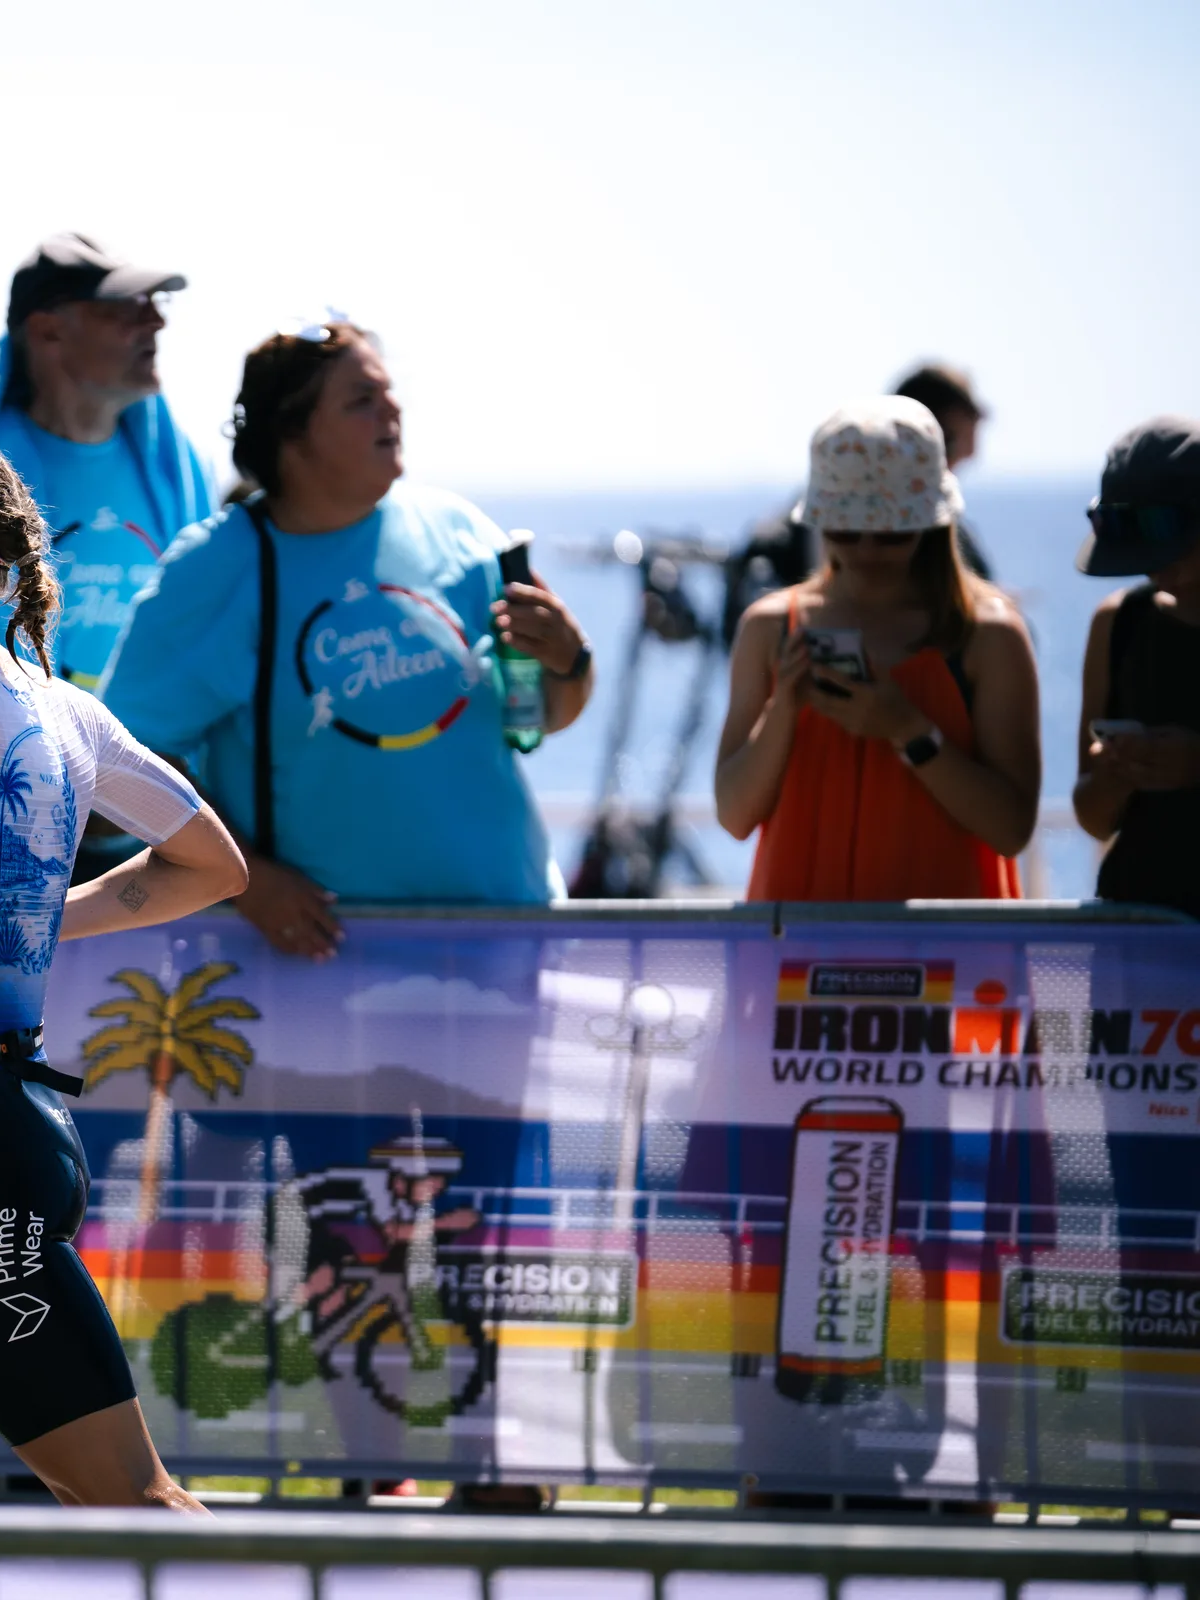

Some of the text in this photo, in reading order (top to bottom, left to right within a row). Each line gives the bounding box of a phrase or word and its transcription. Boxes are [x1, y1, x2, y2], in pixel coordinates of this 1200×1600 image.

[342, 649, 446, 699] Aileen
[773, 1003, 1132, 1056] IRONMAN
[772, 1056, 924, 1085] WORLD
[20, 1211, 45, 1278] Wear
[814, 1140, 863, 1343] PRECISION
[406, 1263, 618, 1293] PRECISION
[854, 1287, 878, 1345] FUEL
